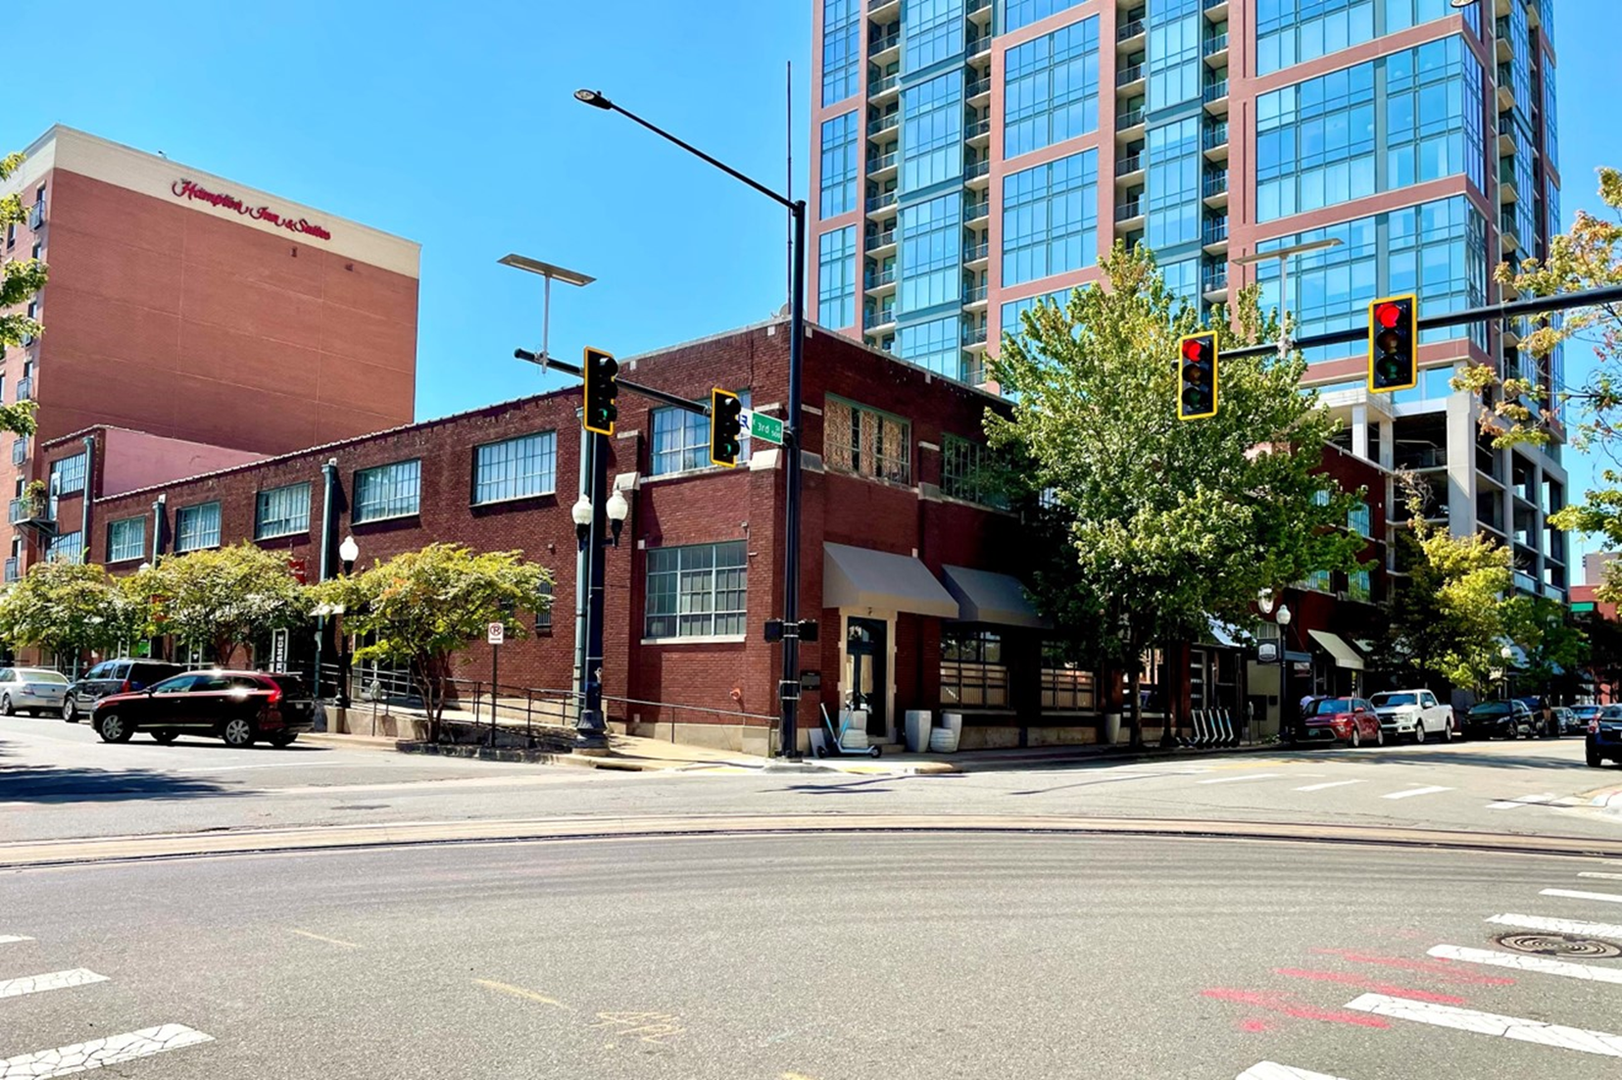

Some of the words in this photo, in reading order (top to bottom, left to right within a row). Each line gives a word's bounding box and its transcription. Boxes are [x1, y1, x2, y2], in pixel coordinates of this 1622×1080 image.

[172, 179, 249, 215] Hampton
[249, 207, 286, 227] Inn
[285, 220, 295, 232] &
[294, 218, 331, 240] Suites
[757, 421, 770, 434] 3rd
